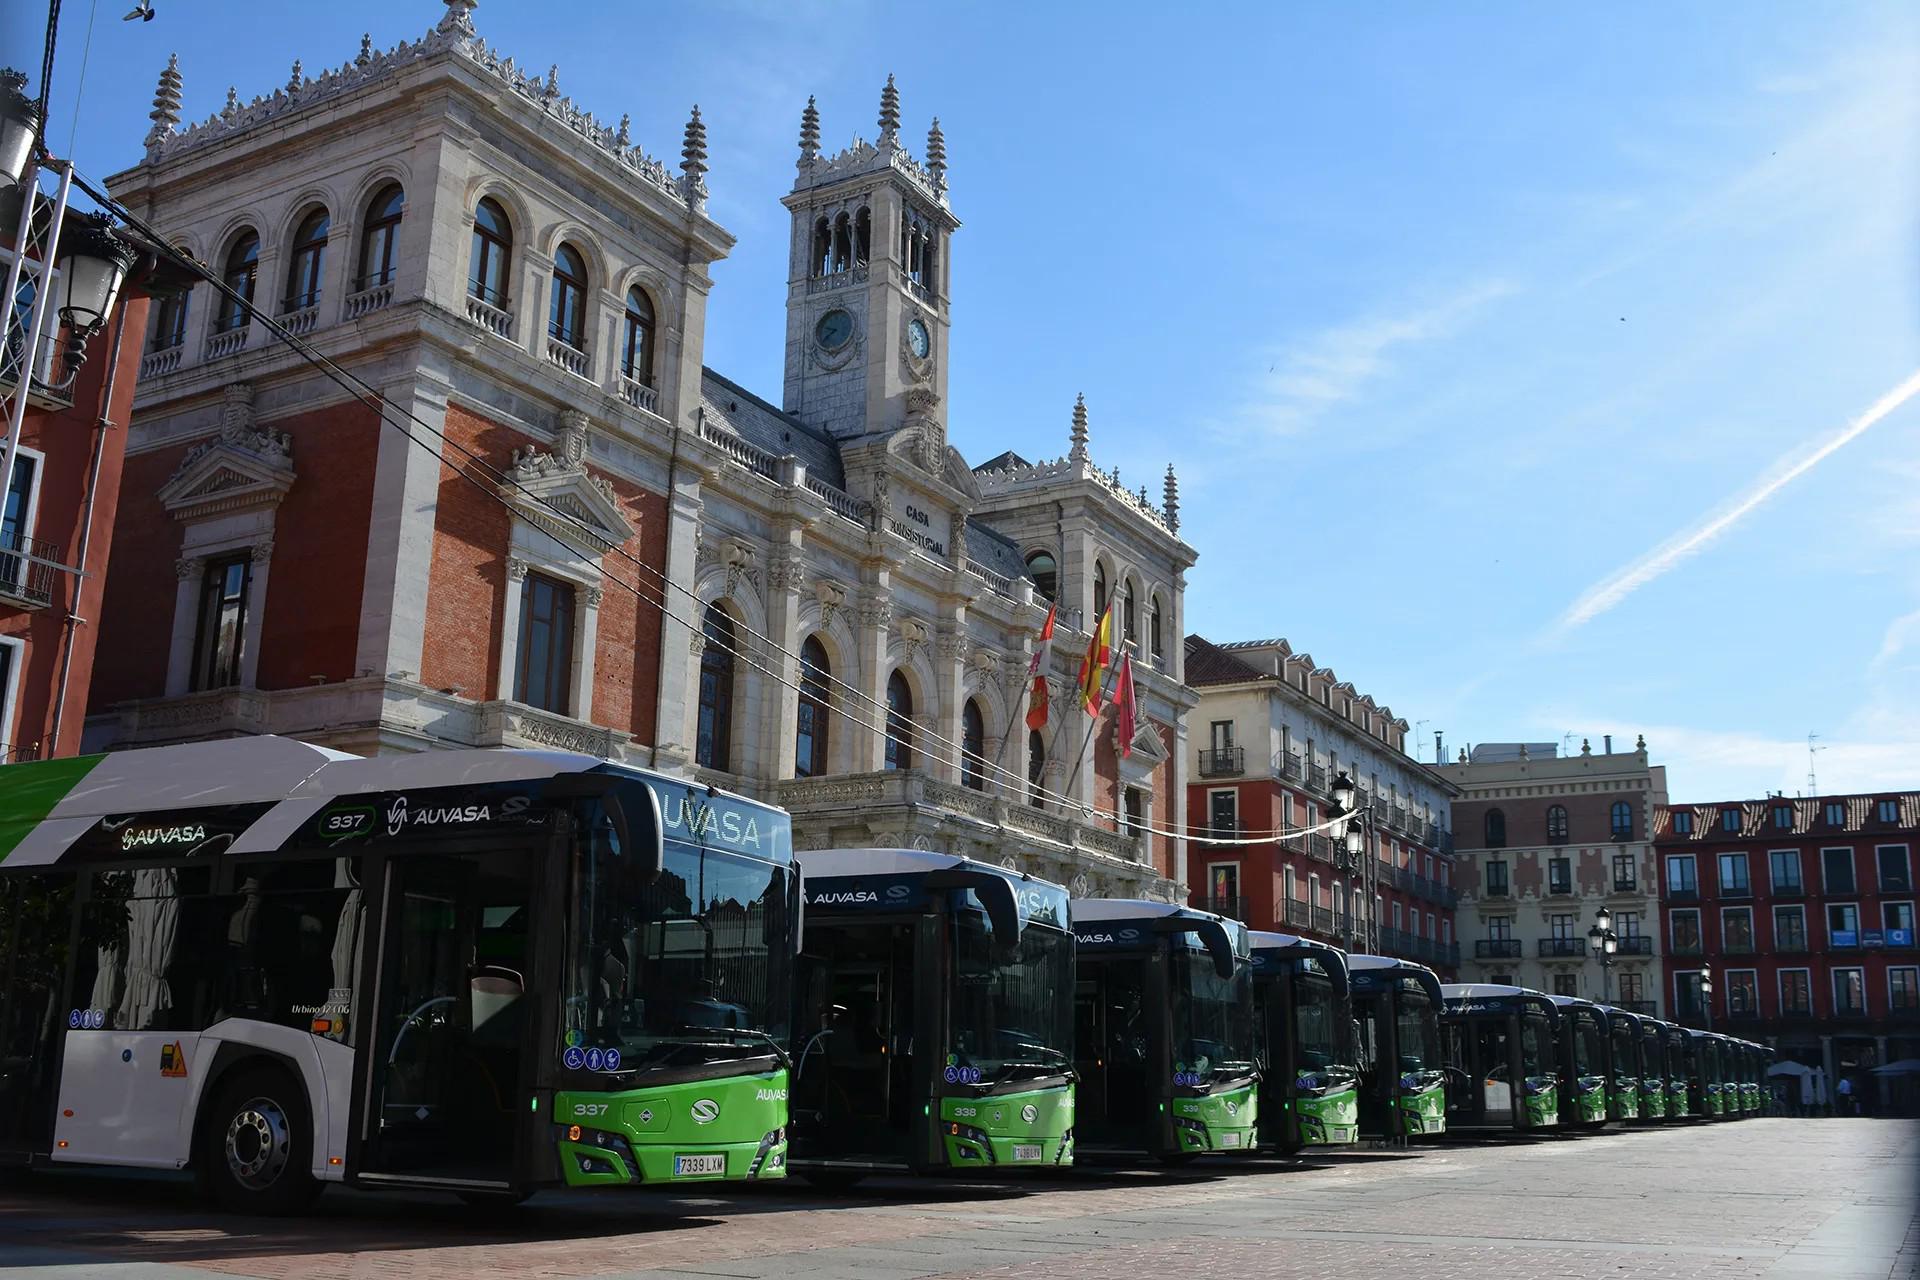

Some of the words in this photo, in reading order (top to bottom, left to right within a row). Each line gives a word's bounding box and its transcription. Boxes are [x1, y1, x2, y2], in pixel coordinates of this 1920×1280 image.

[906, 505, 929, 528] CASA
[328, 814, 365, 830] 337
[414, 805, 491, 825] AUVASA
[663, 794, 761, 849] UVASA
[133, 825, 206, 846] AUVASA
[814, 891, 878, 904] AUVASA
[1075, 933, 1114, 944] VASA
[291, 1004, 321, 1014] Urbino
[574, 1104, 609, 1116] 337
[954, 1107, 977, 1117] 338
[680, 1156, 705, 1174] 7339
[706, 1155, 724, 1172] LXM
